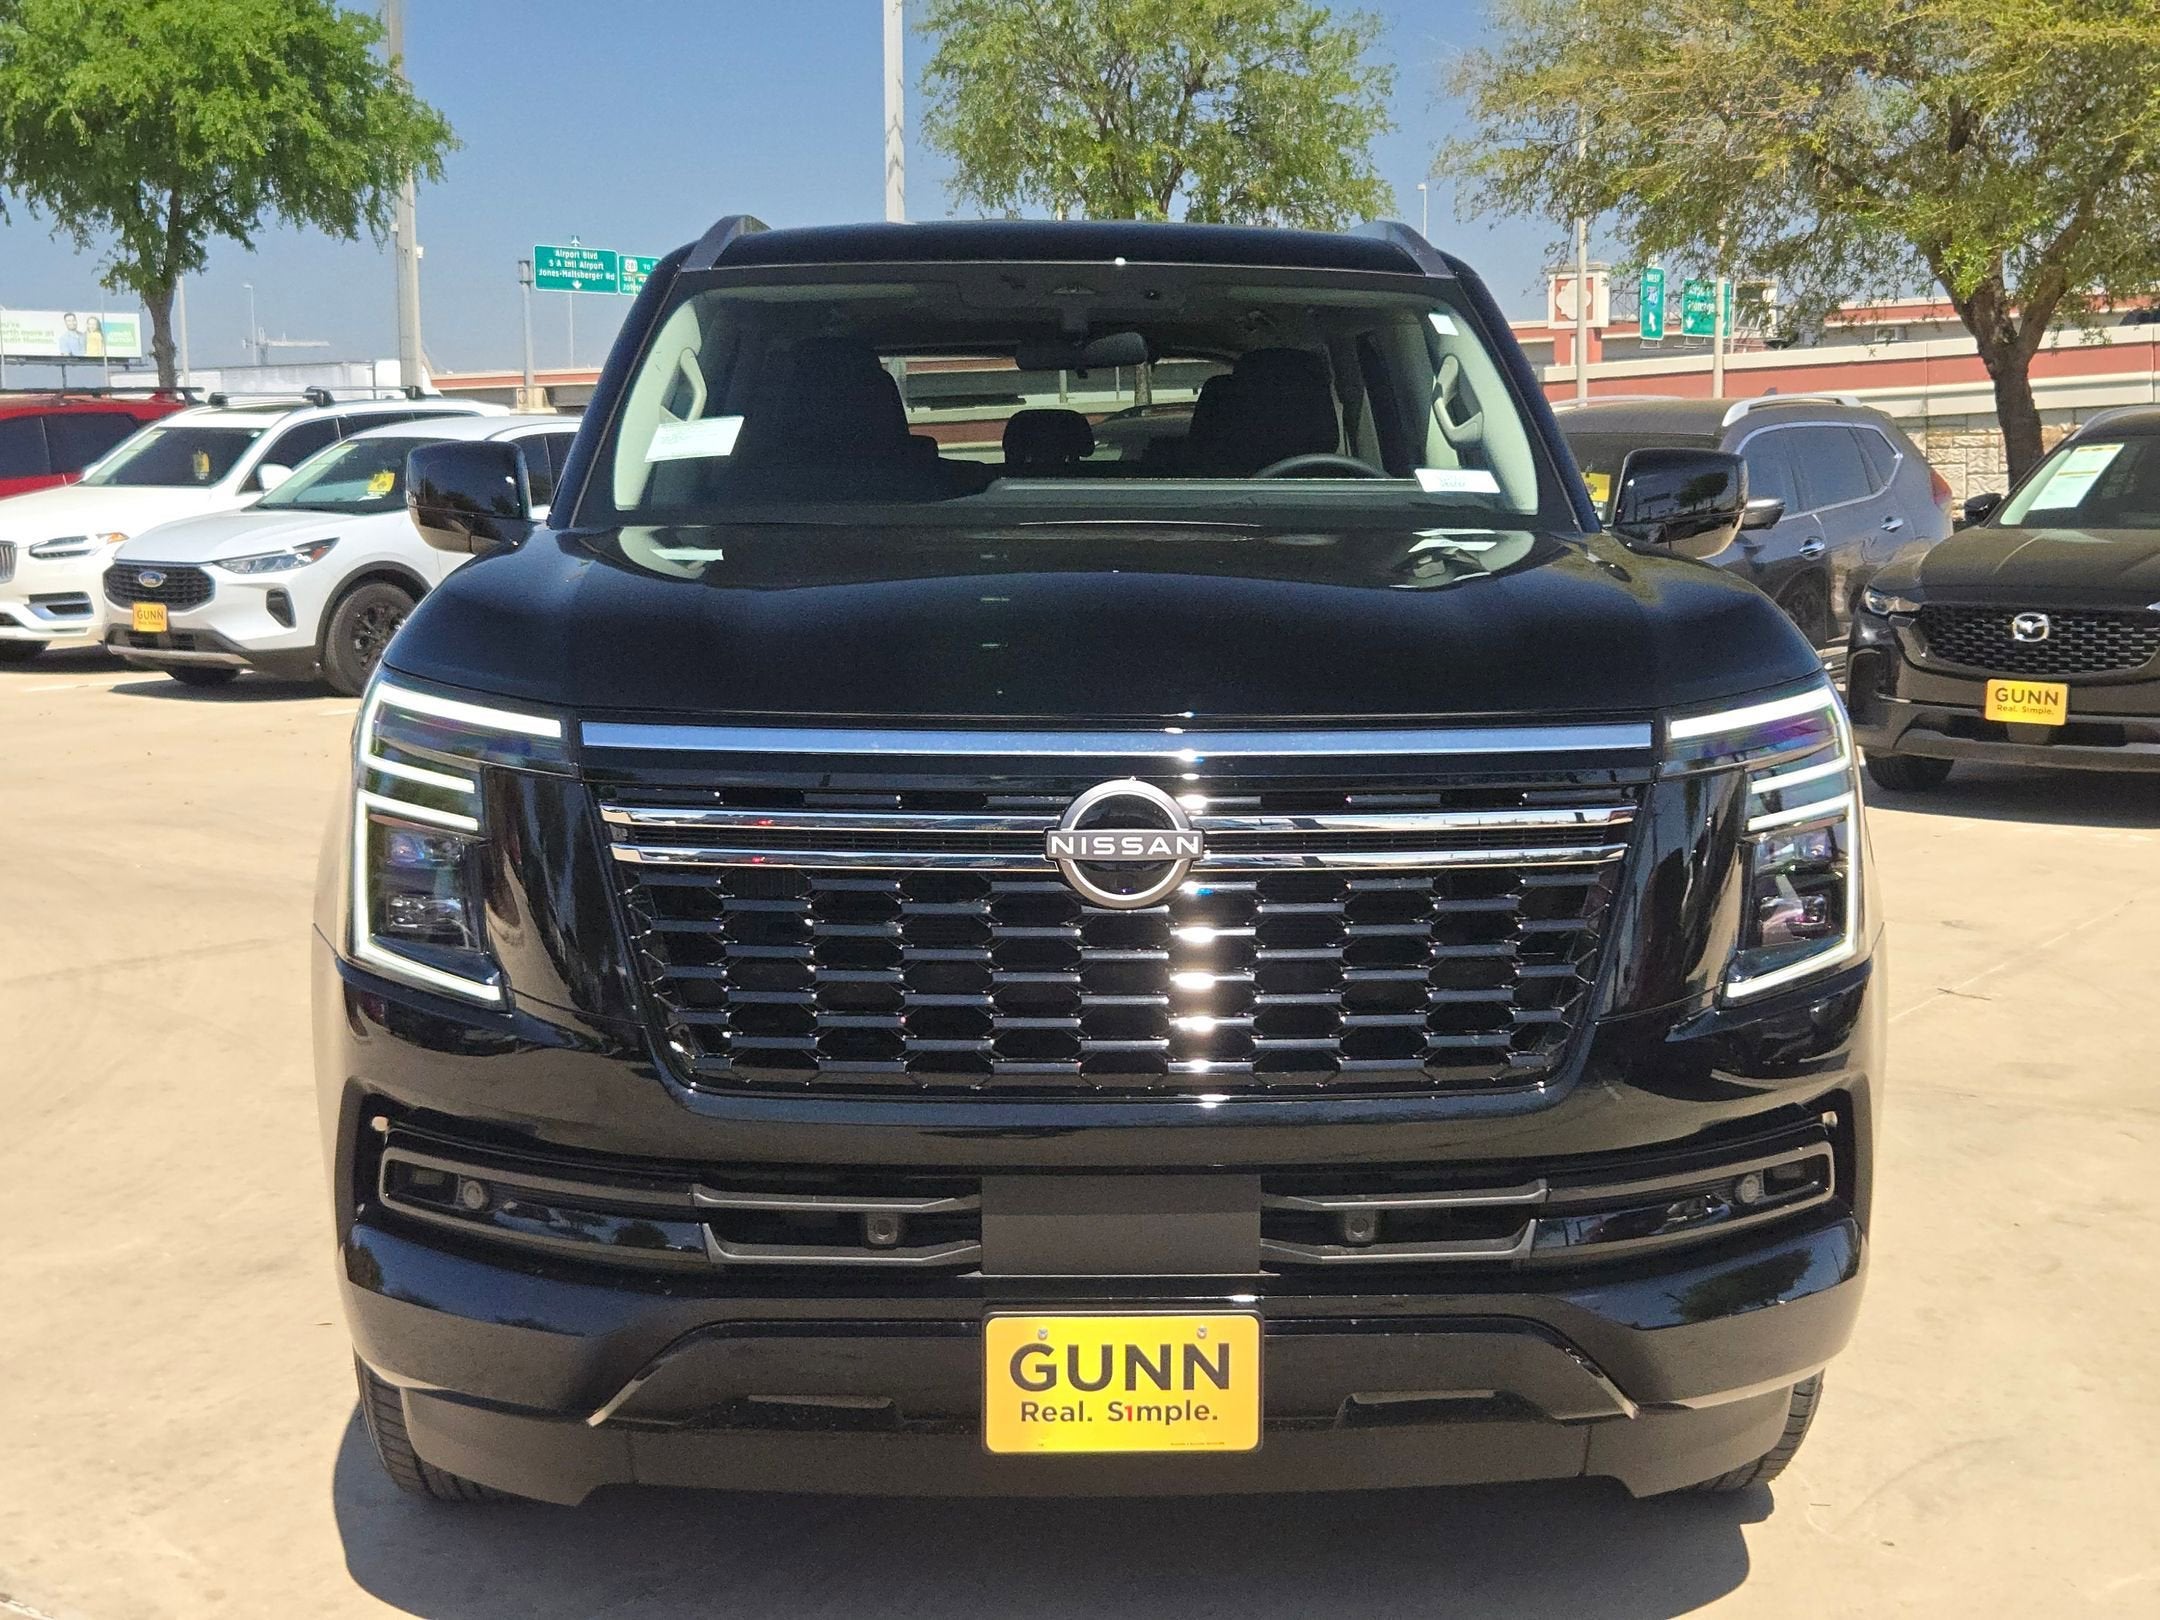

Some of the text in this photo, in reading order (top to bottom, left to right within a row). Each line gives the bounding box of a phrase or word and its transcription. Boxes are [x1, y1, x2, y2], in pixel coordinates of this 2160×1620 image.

[555, 249, 598, 260] Airport Blvd
[579, 262, 604, 271] Airport
[137, 610, 163, 620] GUNN
[1995, 687, 2059, 706] GUNN
[1996, 704, 2018, 712] Real.
[1051, 836, 1199, 855] NISSAN
[1009, 1342, 1230, 1392] GUNN
[1020, 1401, 1093, 1422] Real.
